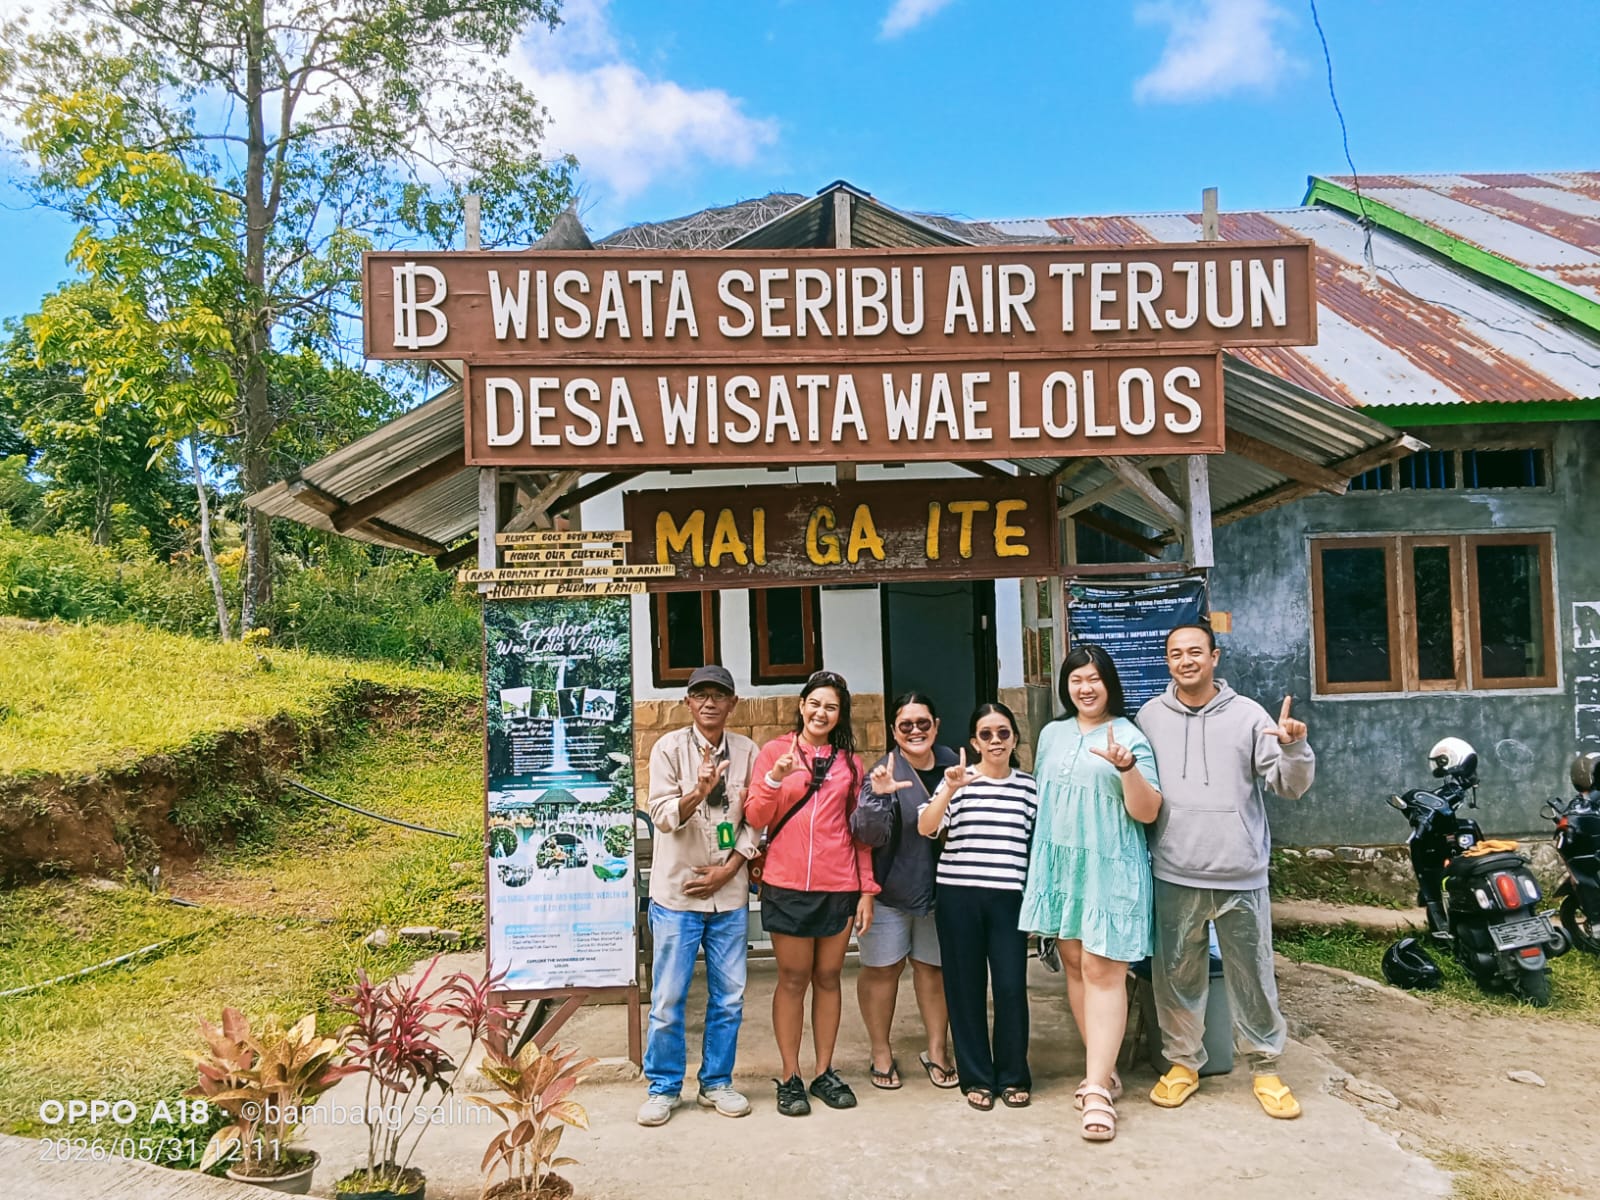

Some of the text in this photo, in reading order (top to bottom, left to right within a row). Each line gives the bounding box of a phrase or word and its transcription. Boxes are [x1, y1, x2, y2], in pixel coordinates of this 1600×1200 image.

[487, 269, 698, 340] WISATA
[717, 266, 925, 337] SERIBU
[944, 263, 1036, 334] AIR
[1049, 258, 1287, 332] TERJUN
[485, 366, 1202, 446] DESA WISATA WAE LOLOS
[542, 533, 561, 542] GOES
[567, 532, 588, 541] BOTH
[655, 500, 1030, 567] MAI GA ITE
[510, 551, 541, 560] HONOR
[545, 550, 566, 560] OUR
[499, 569, 541, 580] HORMAT
[544, 568, 563, 578] ITU
[567, 566, 609, 577] BERLAKU
[615, 567, 634, 575] DUA
[556, 583, 596, 594] BUDAYA
[520, 620, 592, 642] Explore
[496, 635, 620, 657] Wae Lolos Village
